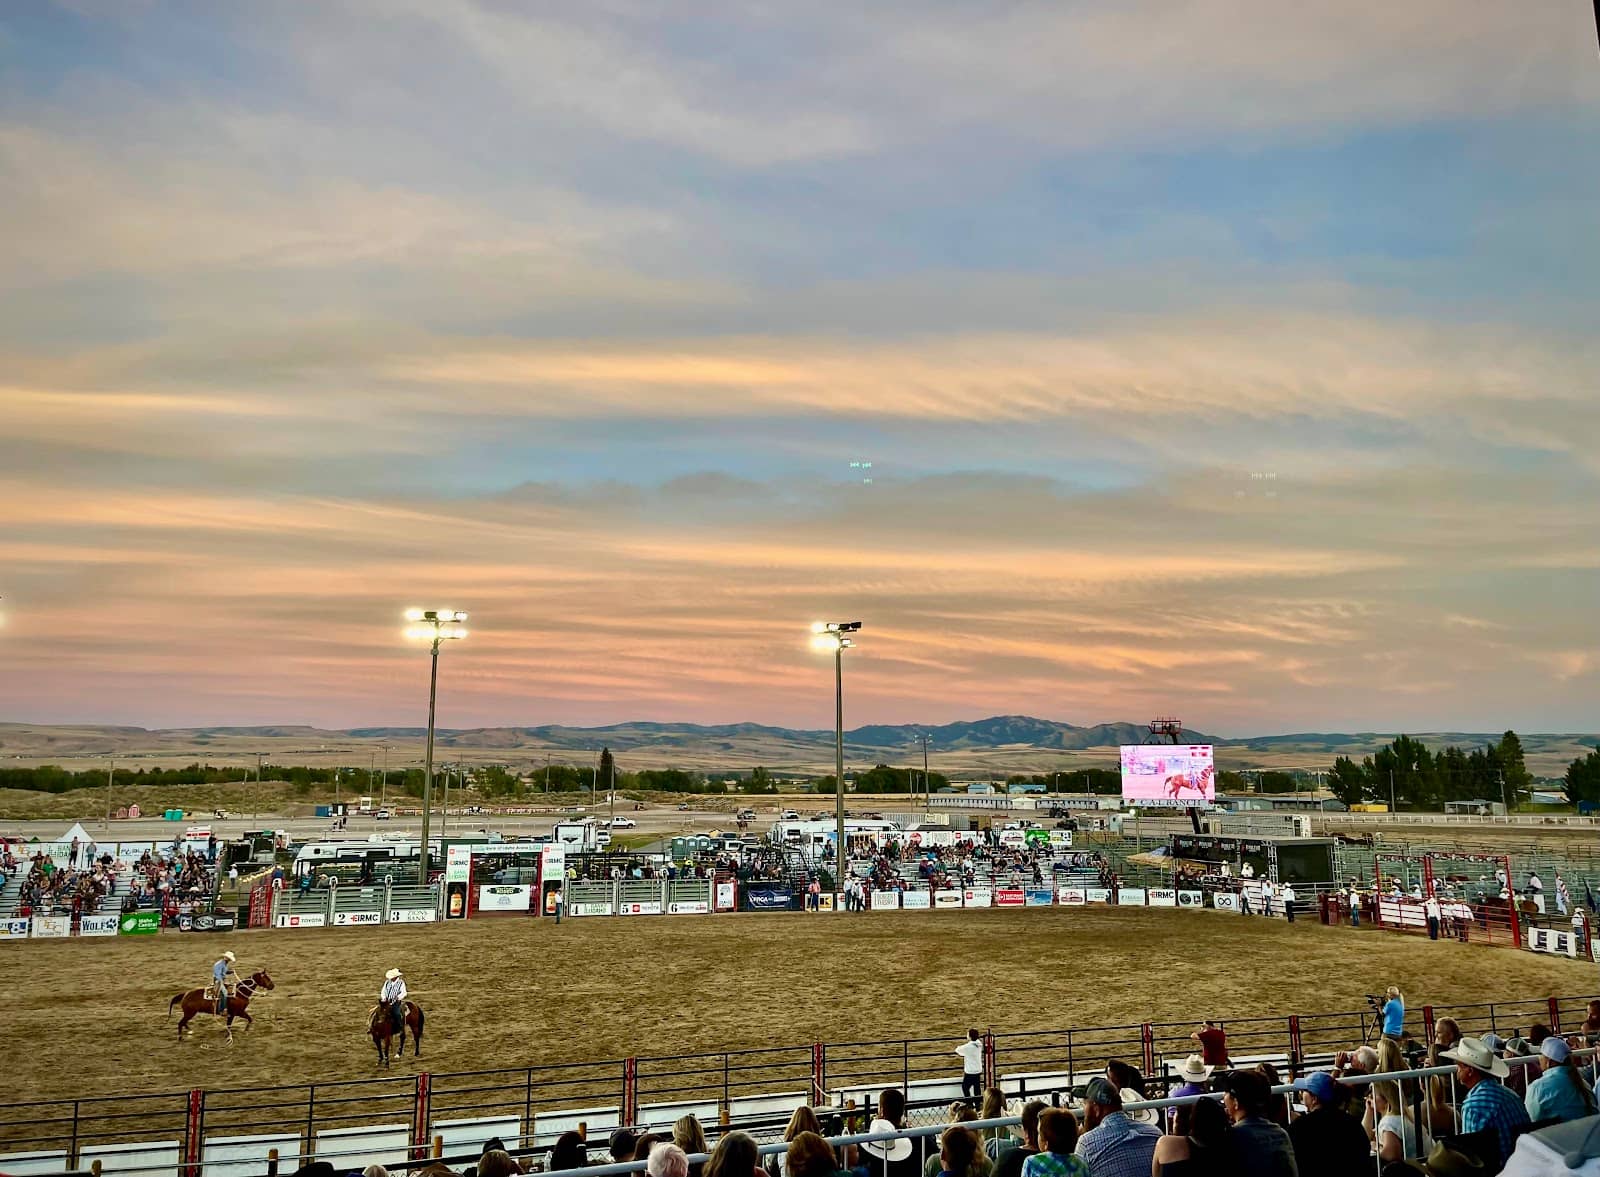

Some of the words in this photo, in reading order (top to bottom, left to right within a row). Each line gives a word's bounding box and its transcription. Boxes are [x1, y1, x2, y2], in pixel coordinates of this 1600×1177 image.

[1150, 891, 1175, 899] EIRMC
[622, 904, 629, 913] 5
[671, 904, 678, 913] 6
[280, 916, 285, 926] 1
[338, 914, 346, 924] 2
[350, 914, 379, 922] EIRMC
[391, 911, 400, 921] 3
[82, 920, 105, 931] WOLF
